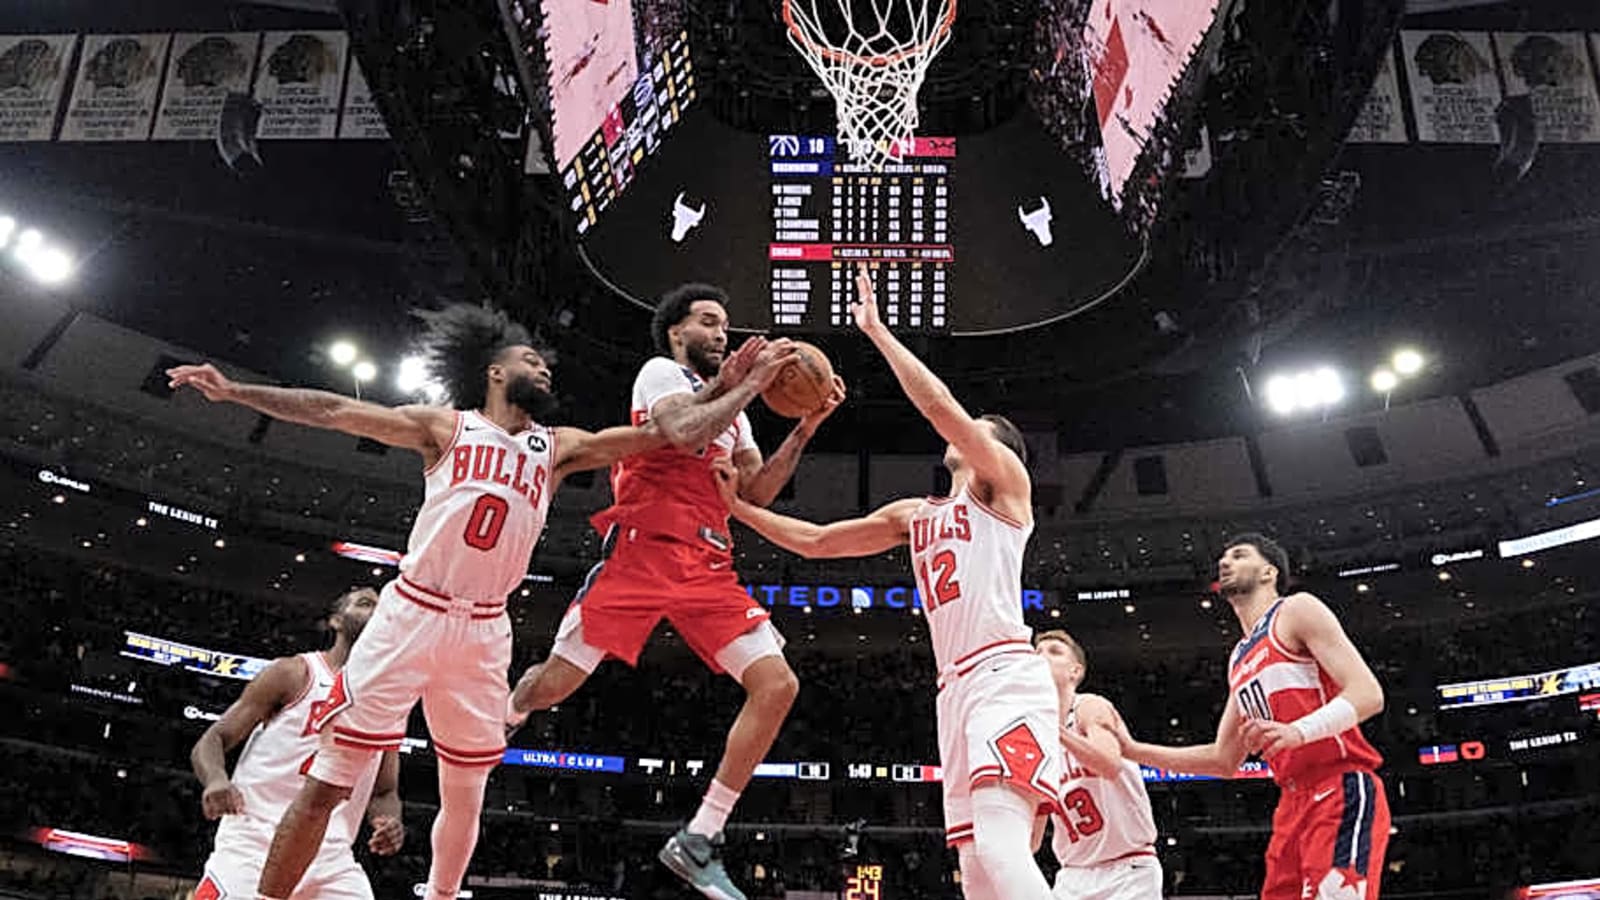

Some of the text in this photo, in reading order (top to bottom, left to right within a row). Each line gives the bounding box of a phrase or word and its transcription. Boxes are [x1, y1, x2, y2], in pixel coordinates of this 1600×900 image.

[450, 444, 546, 509] BULLS
[464, 493, 509, 551] 0
[919, 548, 962, 614] 12
[522, 753, 604, 768] ULTRA CLUB
[1060, 786, 1104, 844] 13
[846, 877, 879, 900] 24
[857, 864, 883, 881] 1:43
